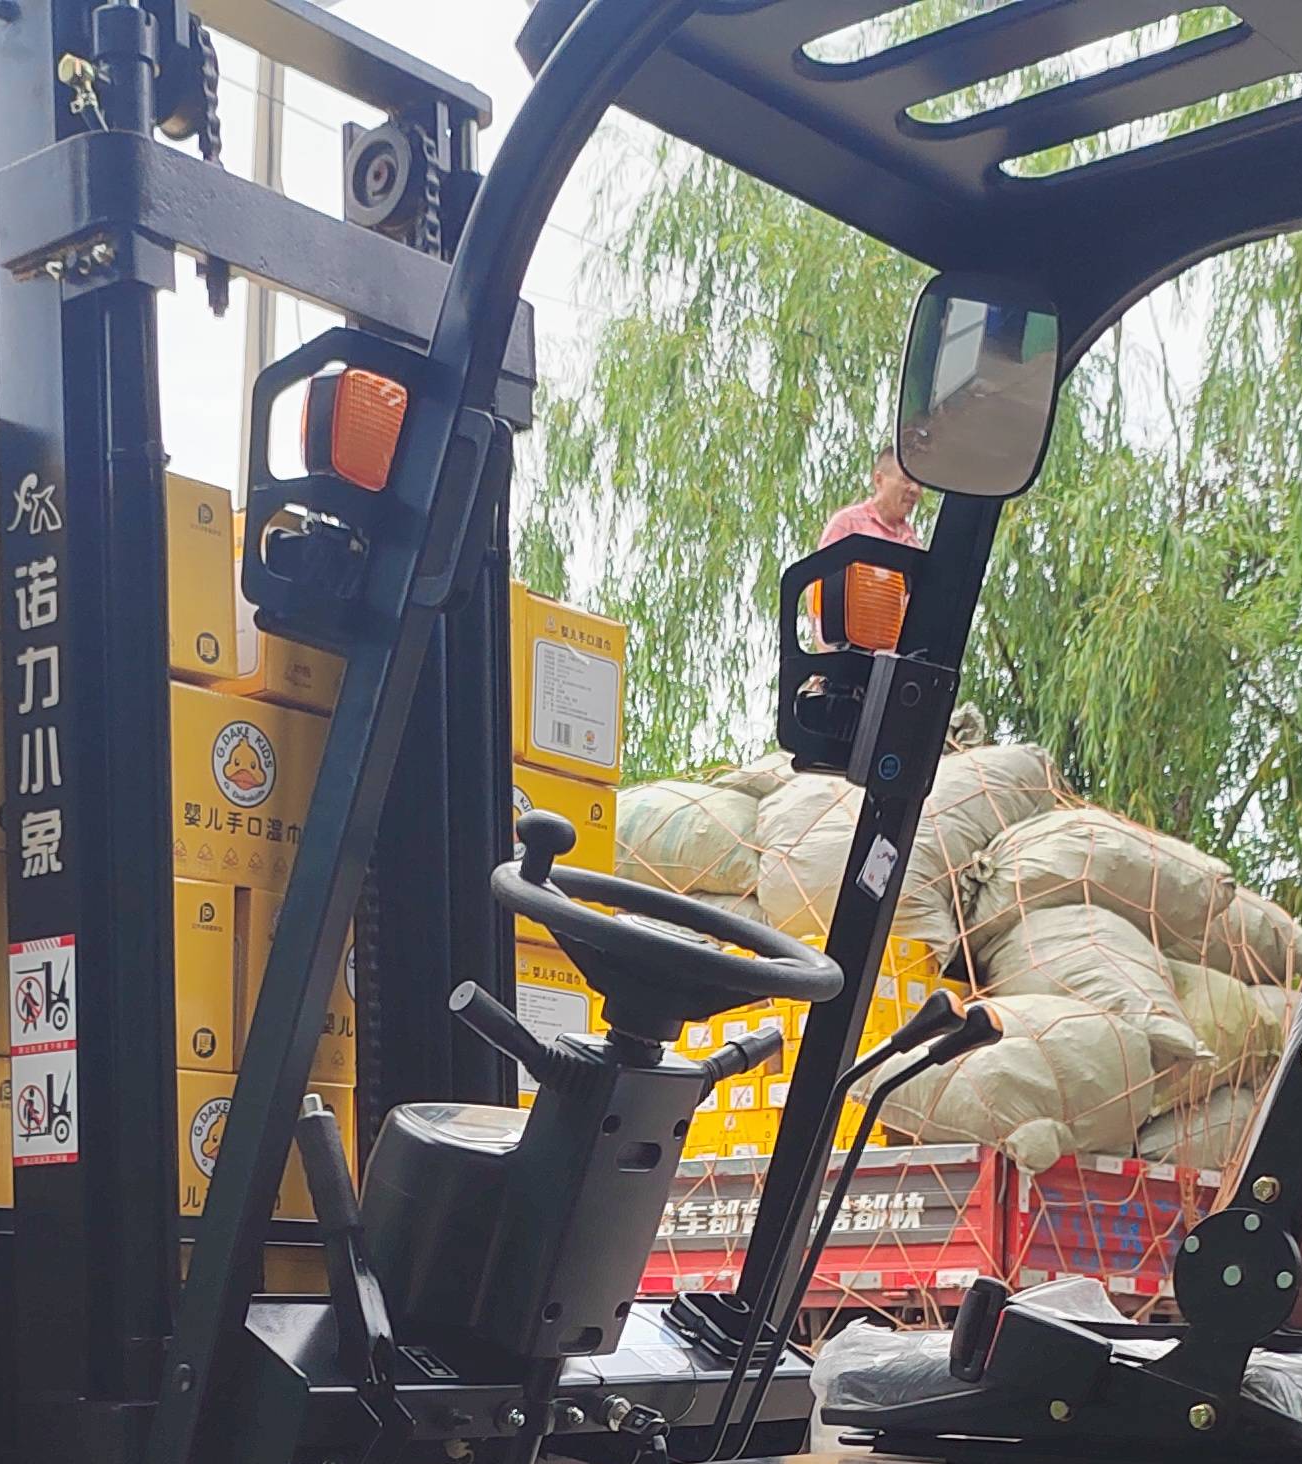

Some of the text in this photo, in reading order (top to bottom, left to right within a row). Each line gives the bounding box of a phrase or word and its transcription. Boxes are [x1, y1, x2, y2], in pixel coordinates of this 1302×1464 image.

[15, 555, 63, 879] 诺力小象
[255, 734, 273, 769] KIDS
[184, 802, 302, 844] 婴儿手口湿巾
